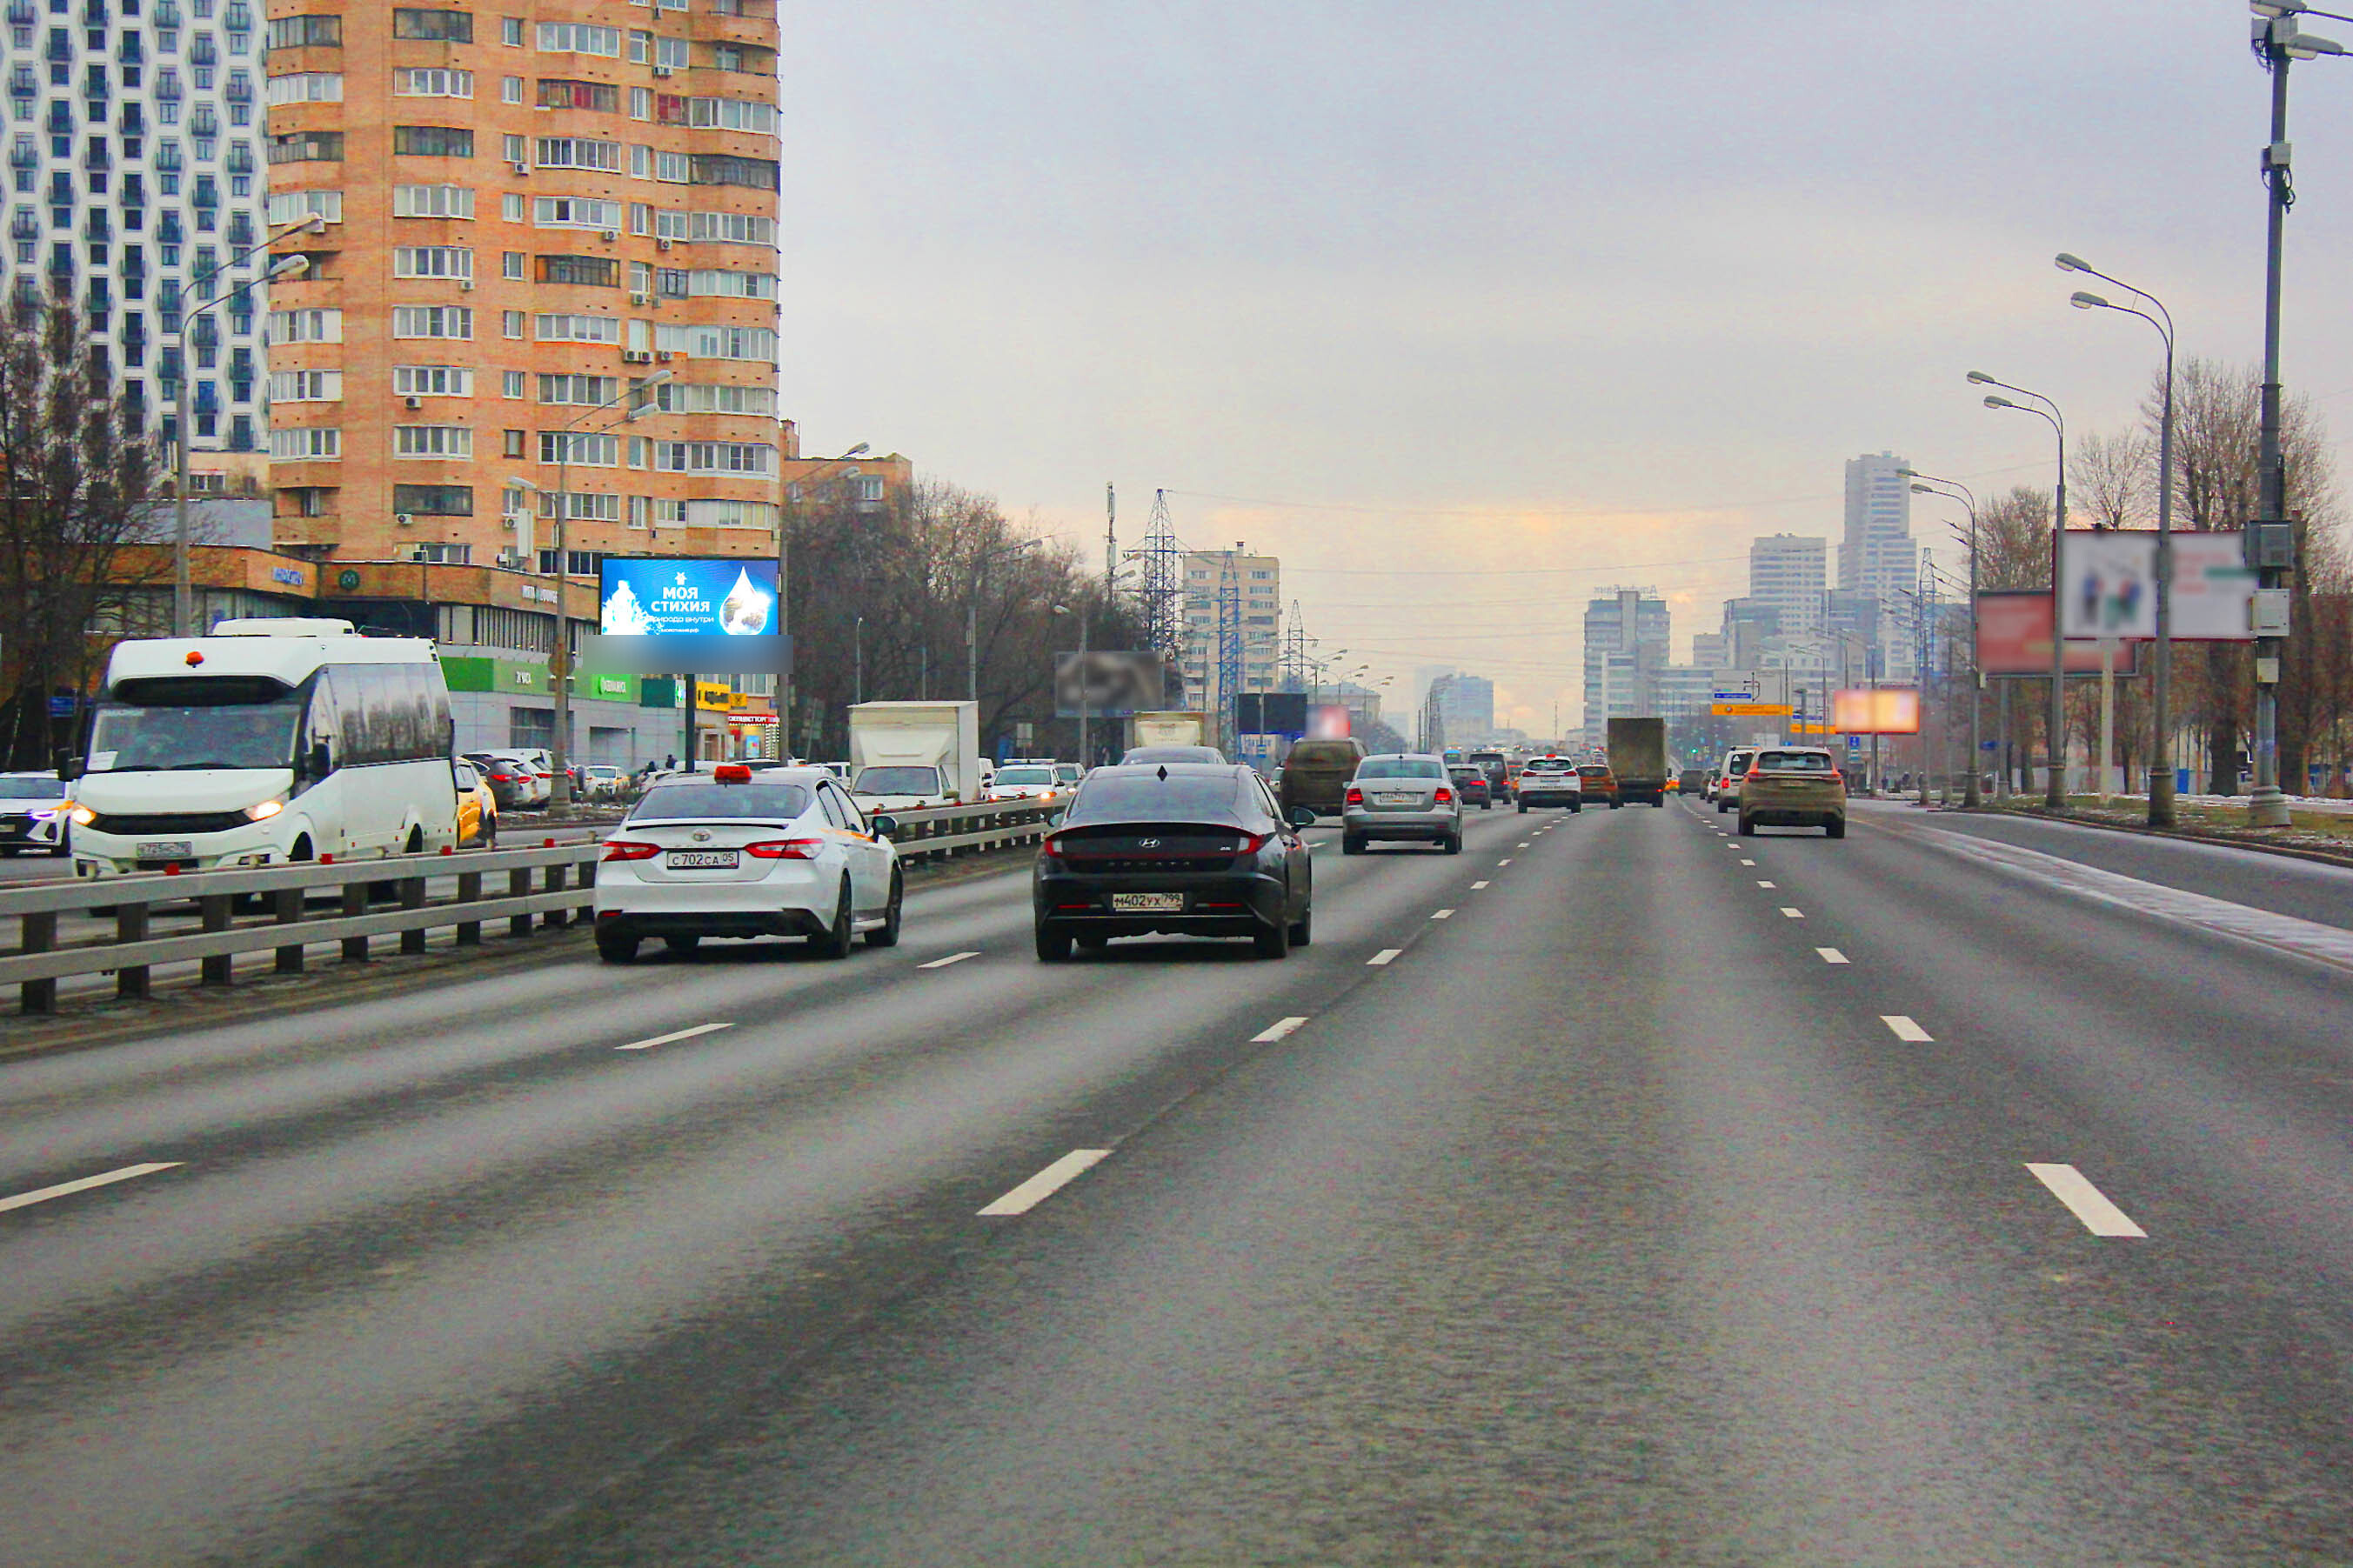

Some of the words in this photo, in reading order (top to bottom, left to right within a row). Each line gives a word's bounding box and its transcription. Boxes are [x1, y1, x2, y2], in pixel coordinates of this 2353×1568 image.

[663, 586, 699, 600] МОЯ
[651, 600, 710, 612] СТИХИЯ
[672, 854, 719, 865] С702СА
[723, 853, 734, 862] 05
[1114, 894, 1160, 906] М402УХ
